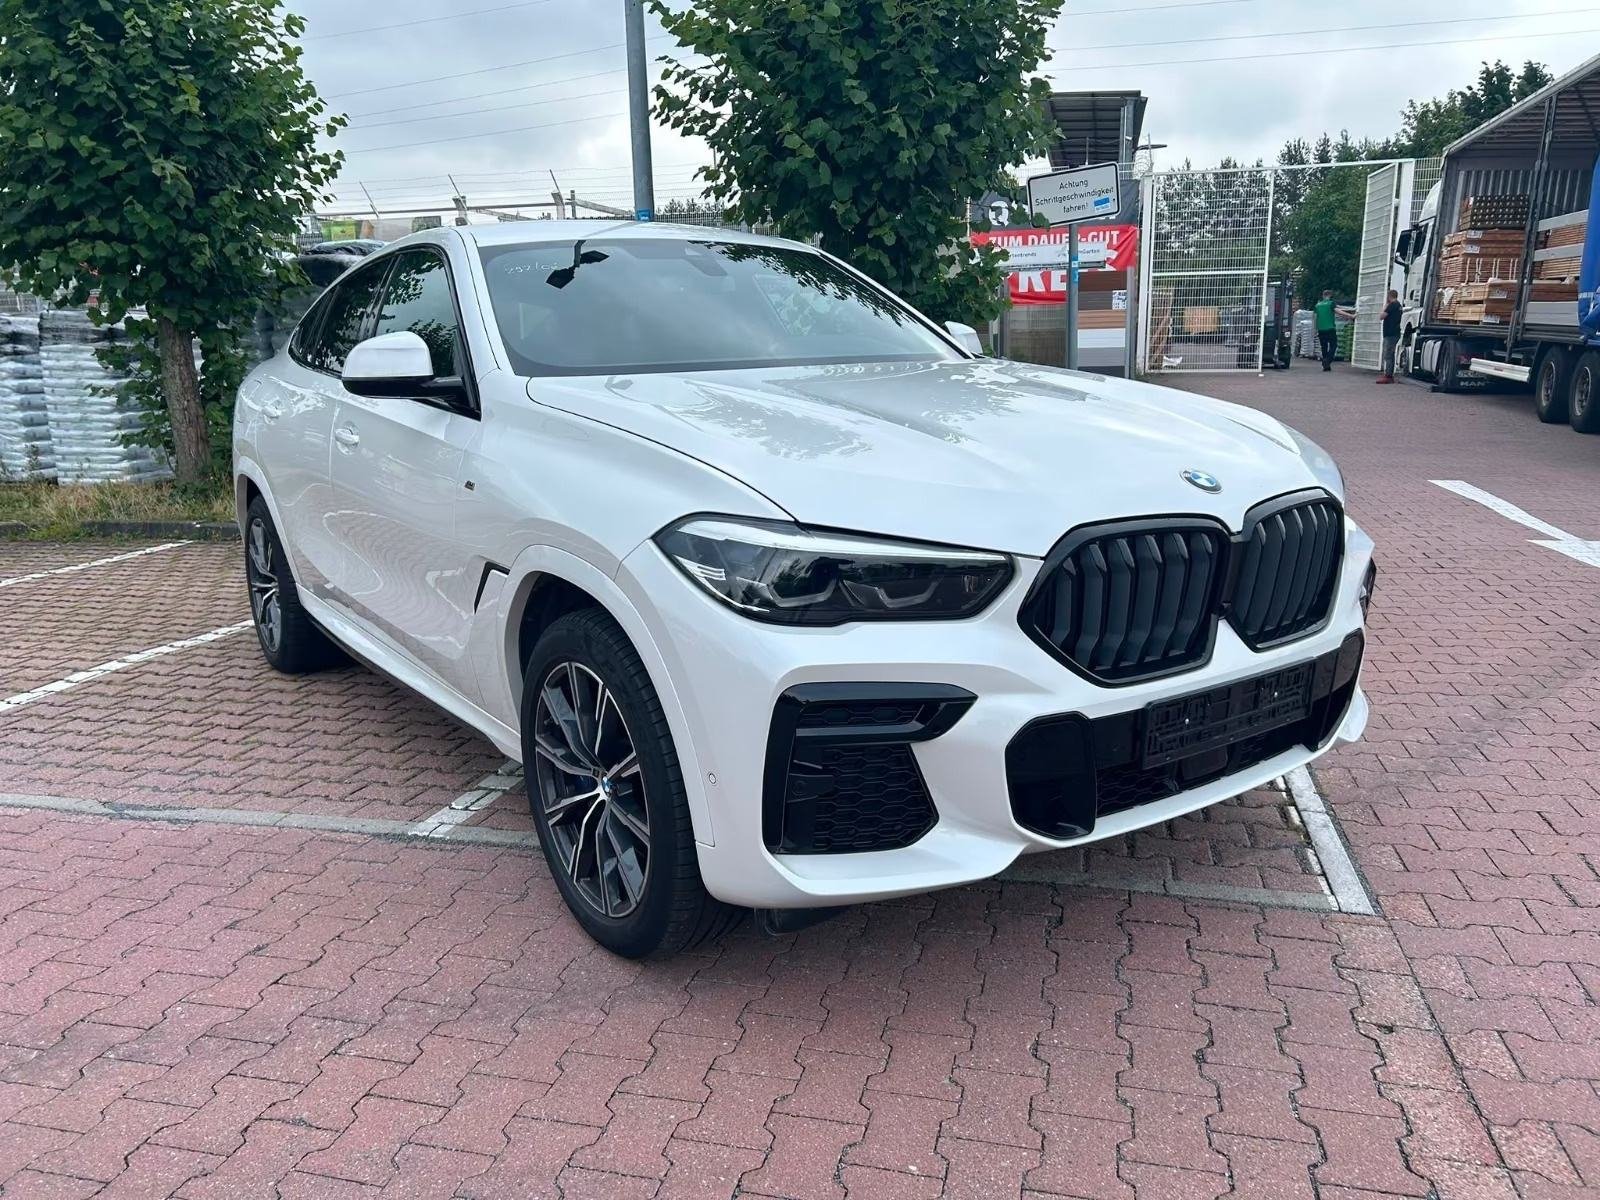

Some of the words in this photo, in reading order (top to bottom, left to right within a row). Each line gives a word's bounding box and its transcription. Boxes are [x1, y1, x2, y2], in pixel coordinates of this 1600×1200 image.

[1059, 179, 1089, 190] Achtung
[1035, 186, 1114, 206] Schrittgeschwindigkeit
[1063, 202, 1088, 213] fahren!
